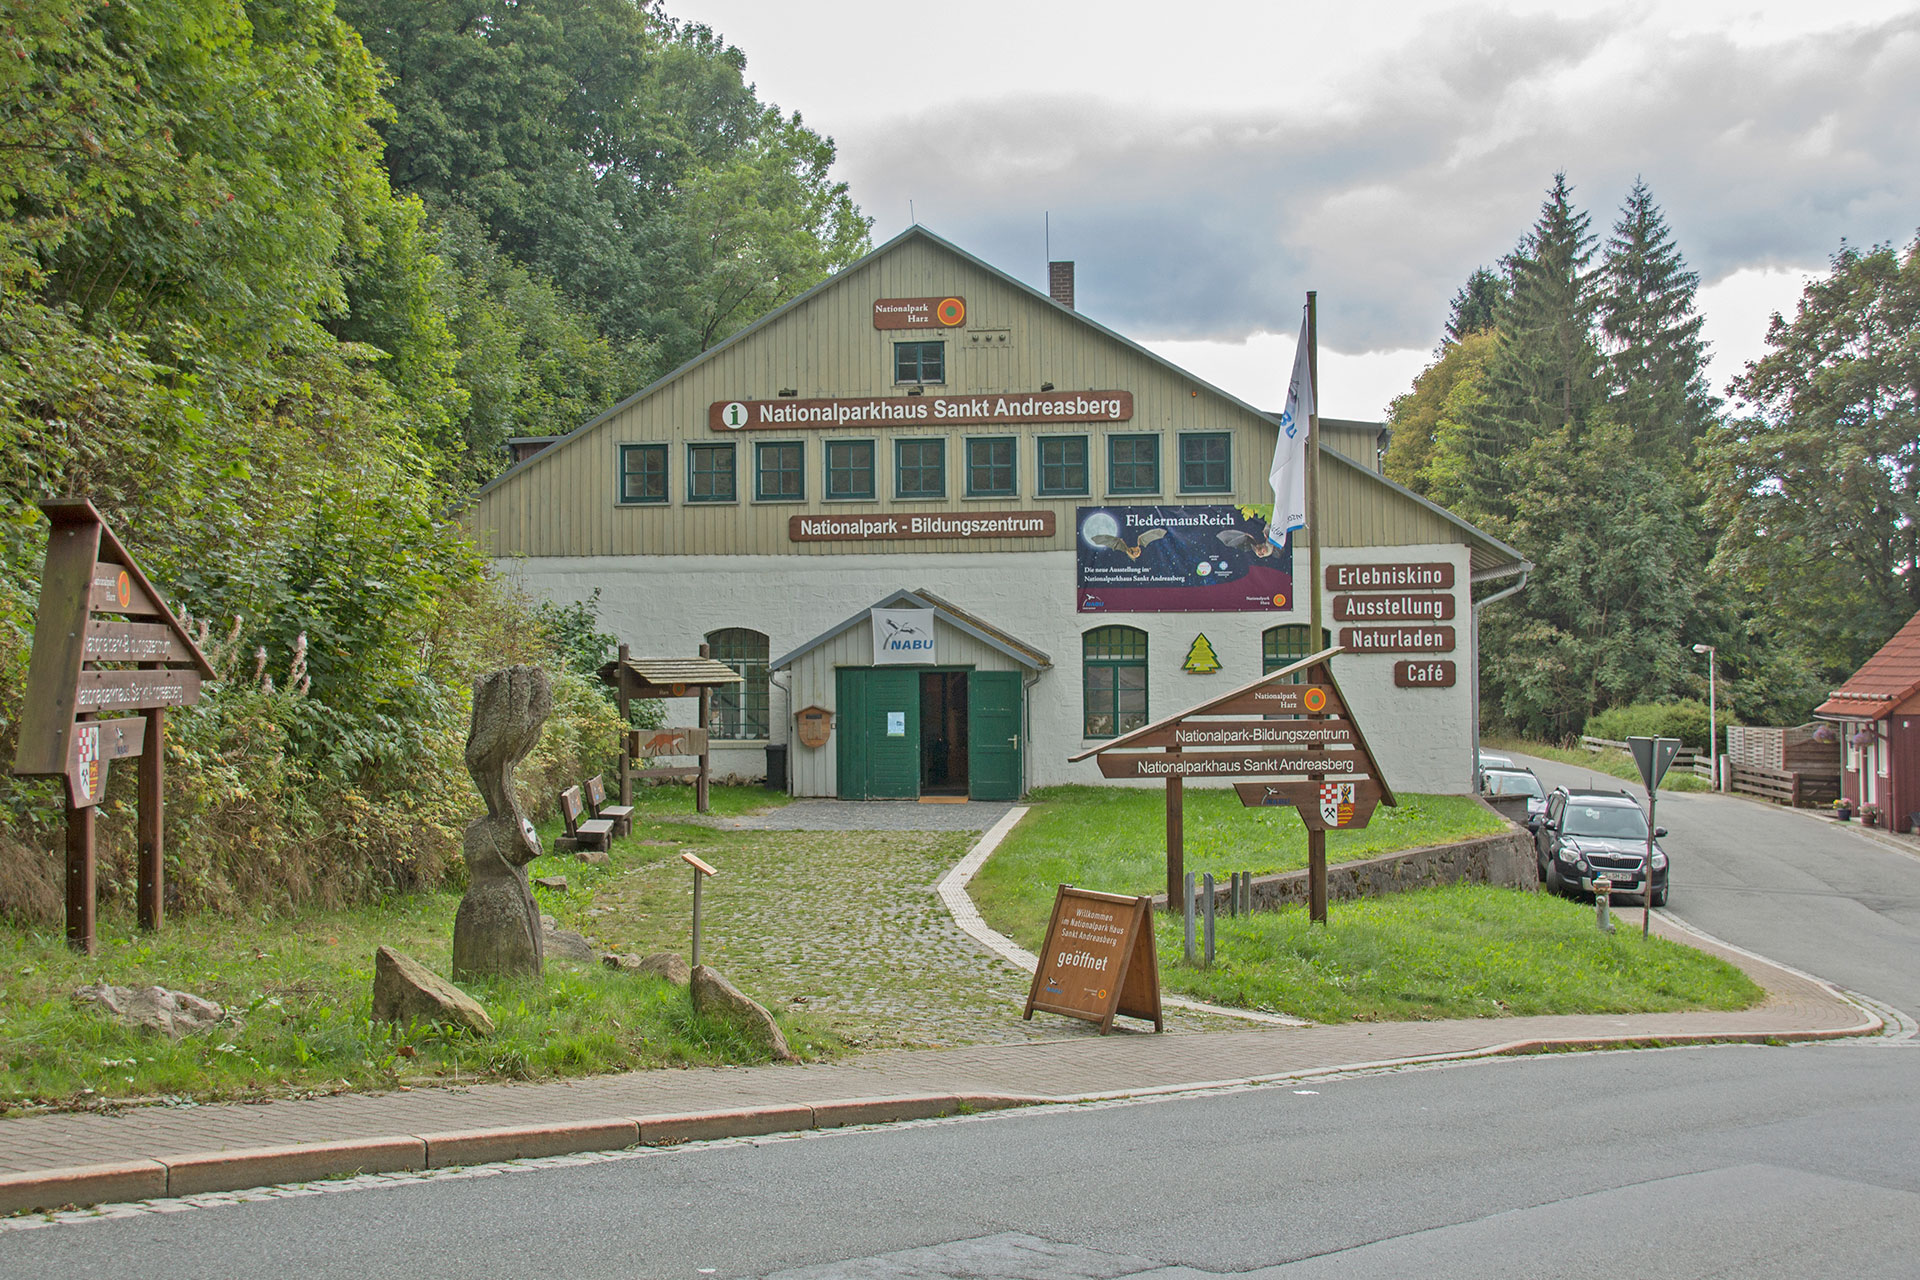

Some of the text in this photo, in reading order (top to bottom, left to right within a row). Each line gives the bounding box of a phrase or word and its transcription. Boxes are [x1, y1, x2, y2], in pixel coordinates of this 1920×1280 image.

[875, 303, 928, 313] Nationalpark
[908, 314, 928, 323] Harz
[760, 402, 928, 425] Nationalparkhaus
[934, 399, 989, 418] Sankt
[994, 396, 1121, 419] Andreasberg
[801, 518, 898, 537] Nationalpark
[911, 516, 1044, 536] Bildungszentrum
[1126, 513, 1235, 527] FledermausReich
[1109, 566, 1141, 574] Ausstellung
[1338, 566, 1443, 585] Erlebniskino
[1084, 575, 1132, 583] Nationalparkhaus
[1150, 575, 1185, 583] Andreasberg
[1346, 597, 1443, 618] Ausstellung
[891, 639, 934, 650] NABU
[1352, 629, 1443, 648] Naturladen
[1407, 664, 1443, 682] Café
[1255, 692, 1297, 701] Nationalpark
[1281, 701, 1297, 709] Harz
[1176, 728, 1350, 743] Nationalpark-Bildungszentrum
[1138, 758, 1354, 774] Nationalparkhaus Sankt Andreasberg
[1076, 908, 1113, 922] Willkommen
[1061, 916, 1124, 935] im Nationalpark Haus
[1061, 927, 1117, 947] Sankt Andreasberg
[1057, 950, 1108, 972] geöffnet
